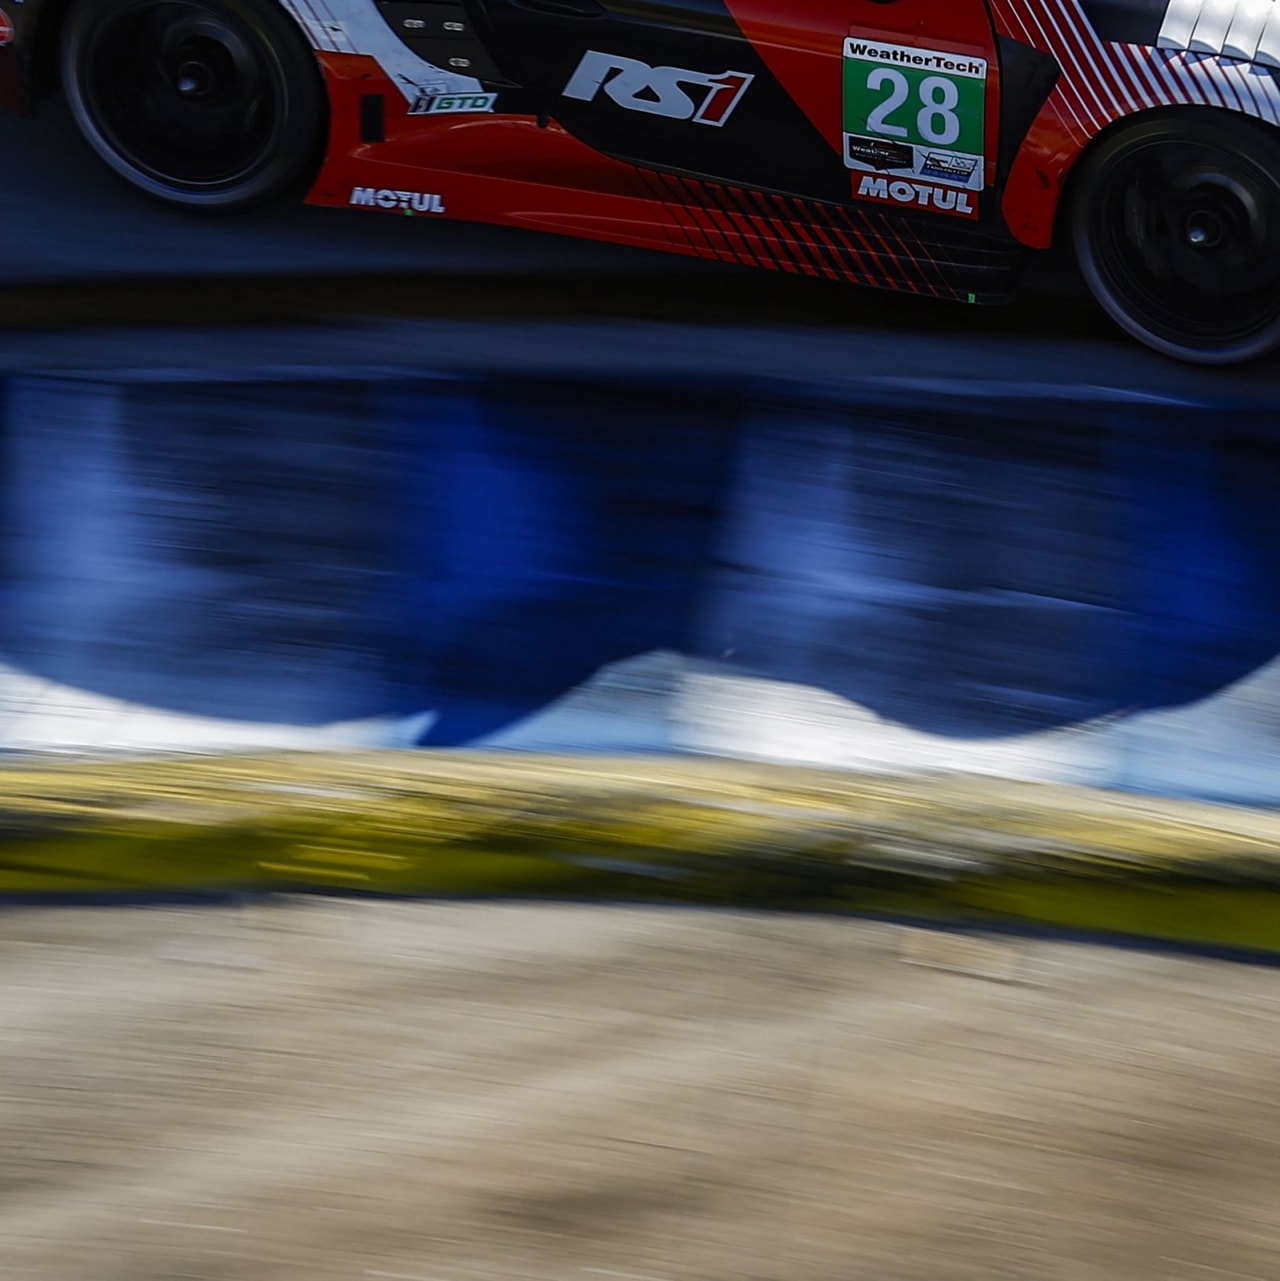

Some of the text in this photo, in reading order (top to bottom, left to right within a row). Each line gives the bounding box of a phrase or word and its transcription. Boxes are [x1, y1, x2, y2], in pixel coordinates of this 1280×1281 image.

[849, 42, 980, 75] WeatherTech
[436, 96, 491, 110] GTD
[865, 67, 960, 145] 28
[350, 188, 445, 213] MOTUL
[857, 175, 973, 214] MOTUL
